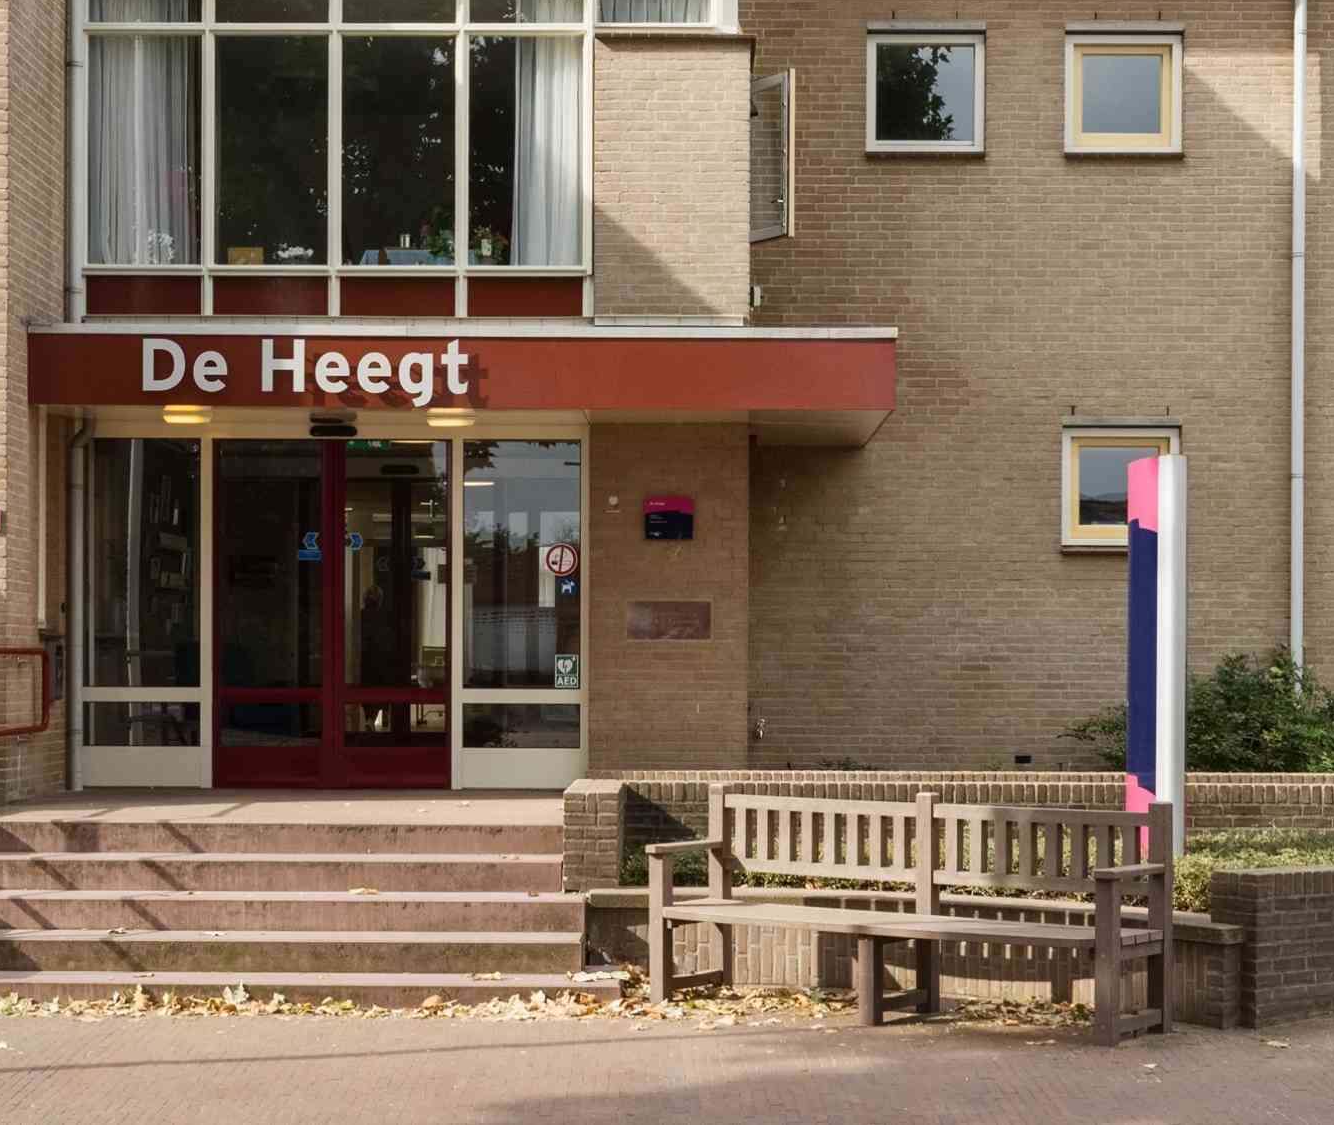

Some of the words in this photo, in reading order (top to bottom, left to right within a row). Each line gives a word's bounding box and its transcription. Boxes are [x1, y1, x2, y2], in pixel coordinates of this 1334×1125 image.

[142, 338, 228, 392] De
[261, 338, 468, 407] Heegt
[557, 676, 577, 685] AED
